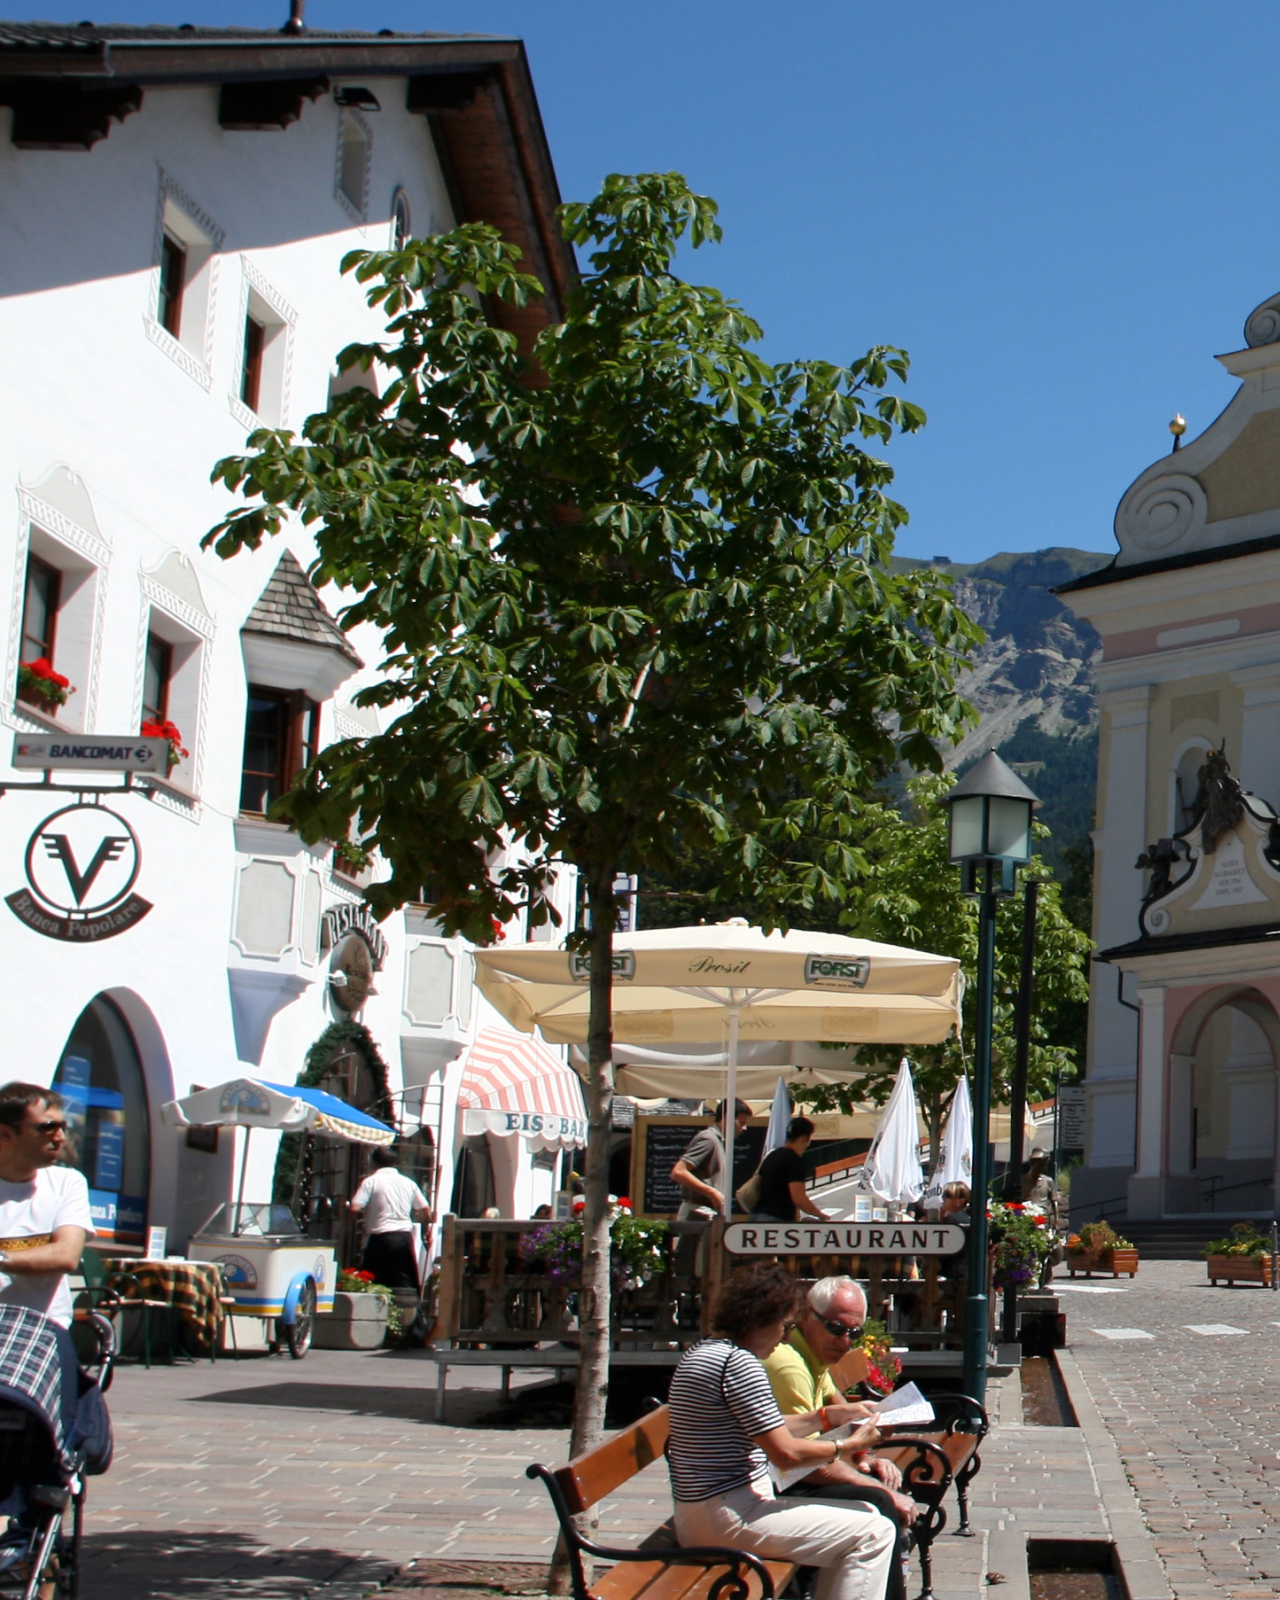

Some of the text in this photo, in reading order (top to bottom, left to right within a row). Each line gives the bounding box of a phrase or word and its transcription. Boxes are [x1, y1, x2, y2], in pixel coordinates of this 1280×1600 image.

[49, 744, 133, 760] BANCOMAT
[13, 893, 141, 938] Banca Popolare
[575, 955, 630, 972] FOST
[688, 955, 752, 974] Prosit
[811, 959, 865, 979] FORST
[505, 1113, 585, 1138] EIS BAR
[740, 1228, 950, 1249] RESTAURANT
